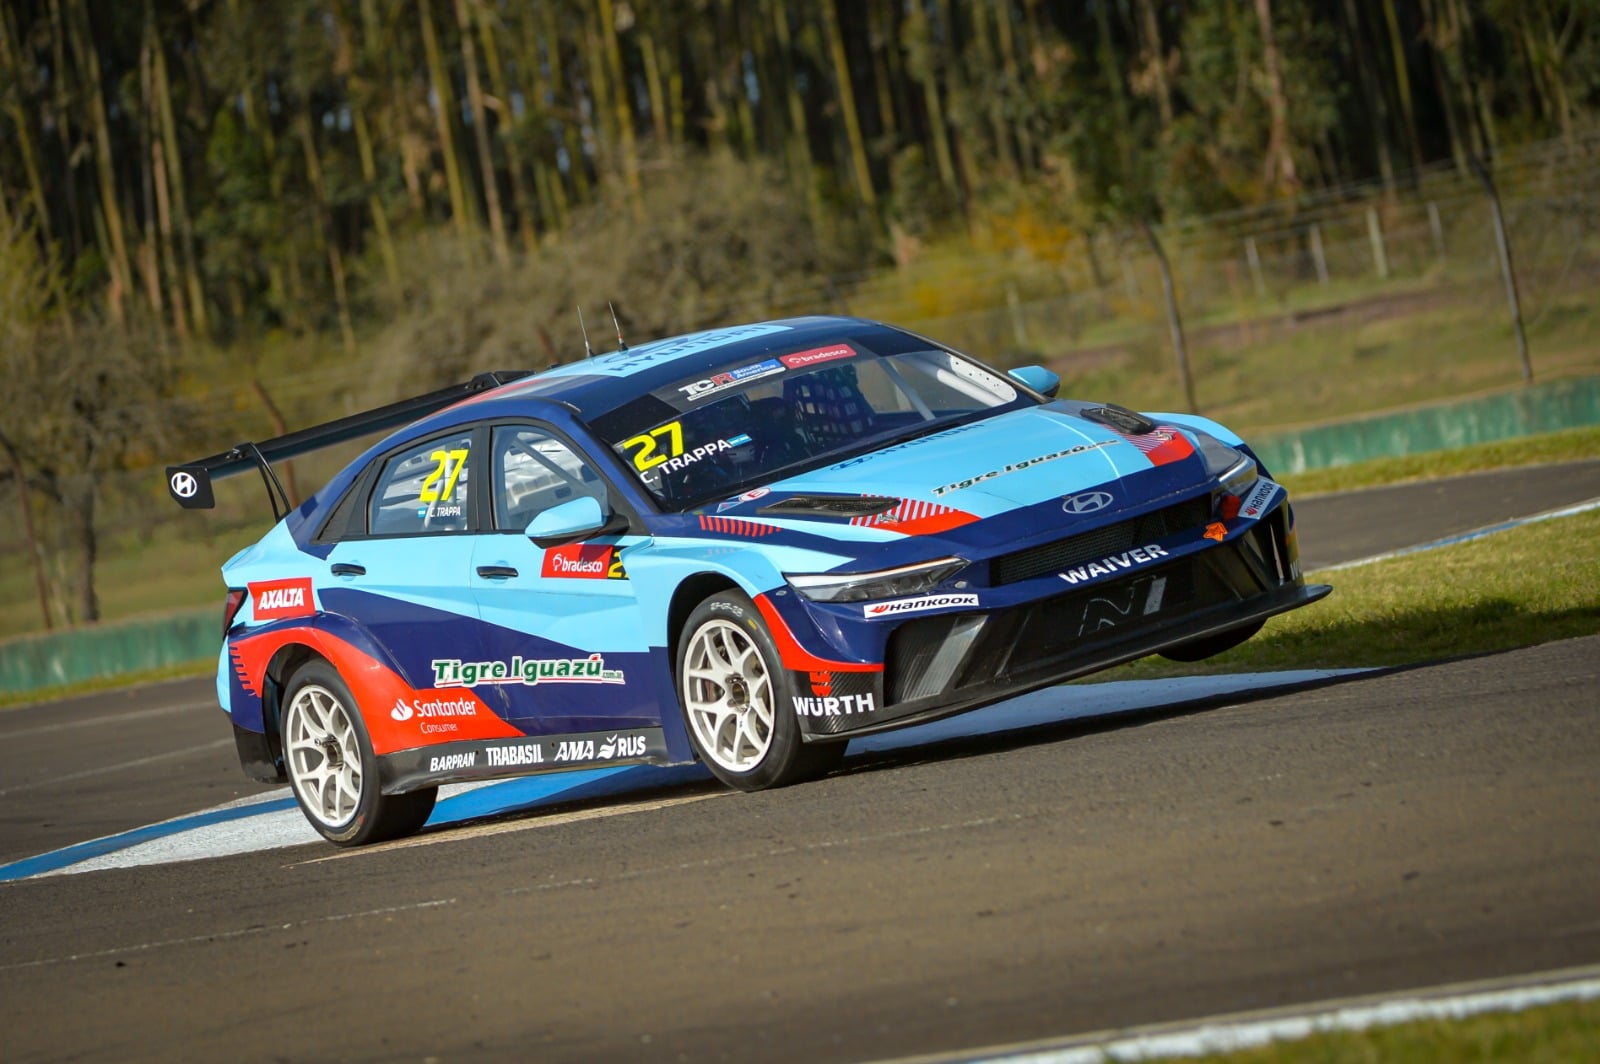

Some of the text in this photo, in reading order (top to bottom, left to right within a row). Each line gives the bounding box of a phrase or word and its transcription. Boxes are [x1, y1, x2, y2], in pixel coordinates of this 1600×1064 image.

[607, 326, 768, 372] HYUNDAI
[800, 349, 849, 362] bradesco
[734, 363, 762, 375] South
[678, 372, 738, 397] TCR
[623, 420, 685, 472] 27
[659, 438, 733, 475] TRAPPA
[419, 449, 469, 503] 27
[931, 470, 998, 497] Tigre
[436, 506, 462, 517] TRAPPA
[561, 556, 603, 573] bradesco
[607, 551, 629, 578] 2
[1058, 543, 1169, 585] WAIVER
[257, 588, 305, 610] AXALTA
[432, 659, 506, 685] Tigre
[512, 654, 603, 684] Iguazú
[413, 697, 477, 718] Santander
[792, 692, 875, 717] WÜRTH
[420, 721, 458, 734] Consumer
[486, 744, 544, 767] TRABASIL
[554, 740, 594, 762] AMA
[617, 735, 646, 756] RUS
[430, 751, 475, 772] BARPRAN
